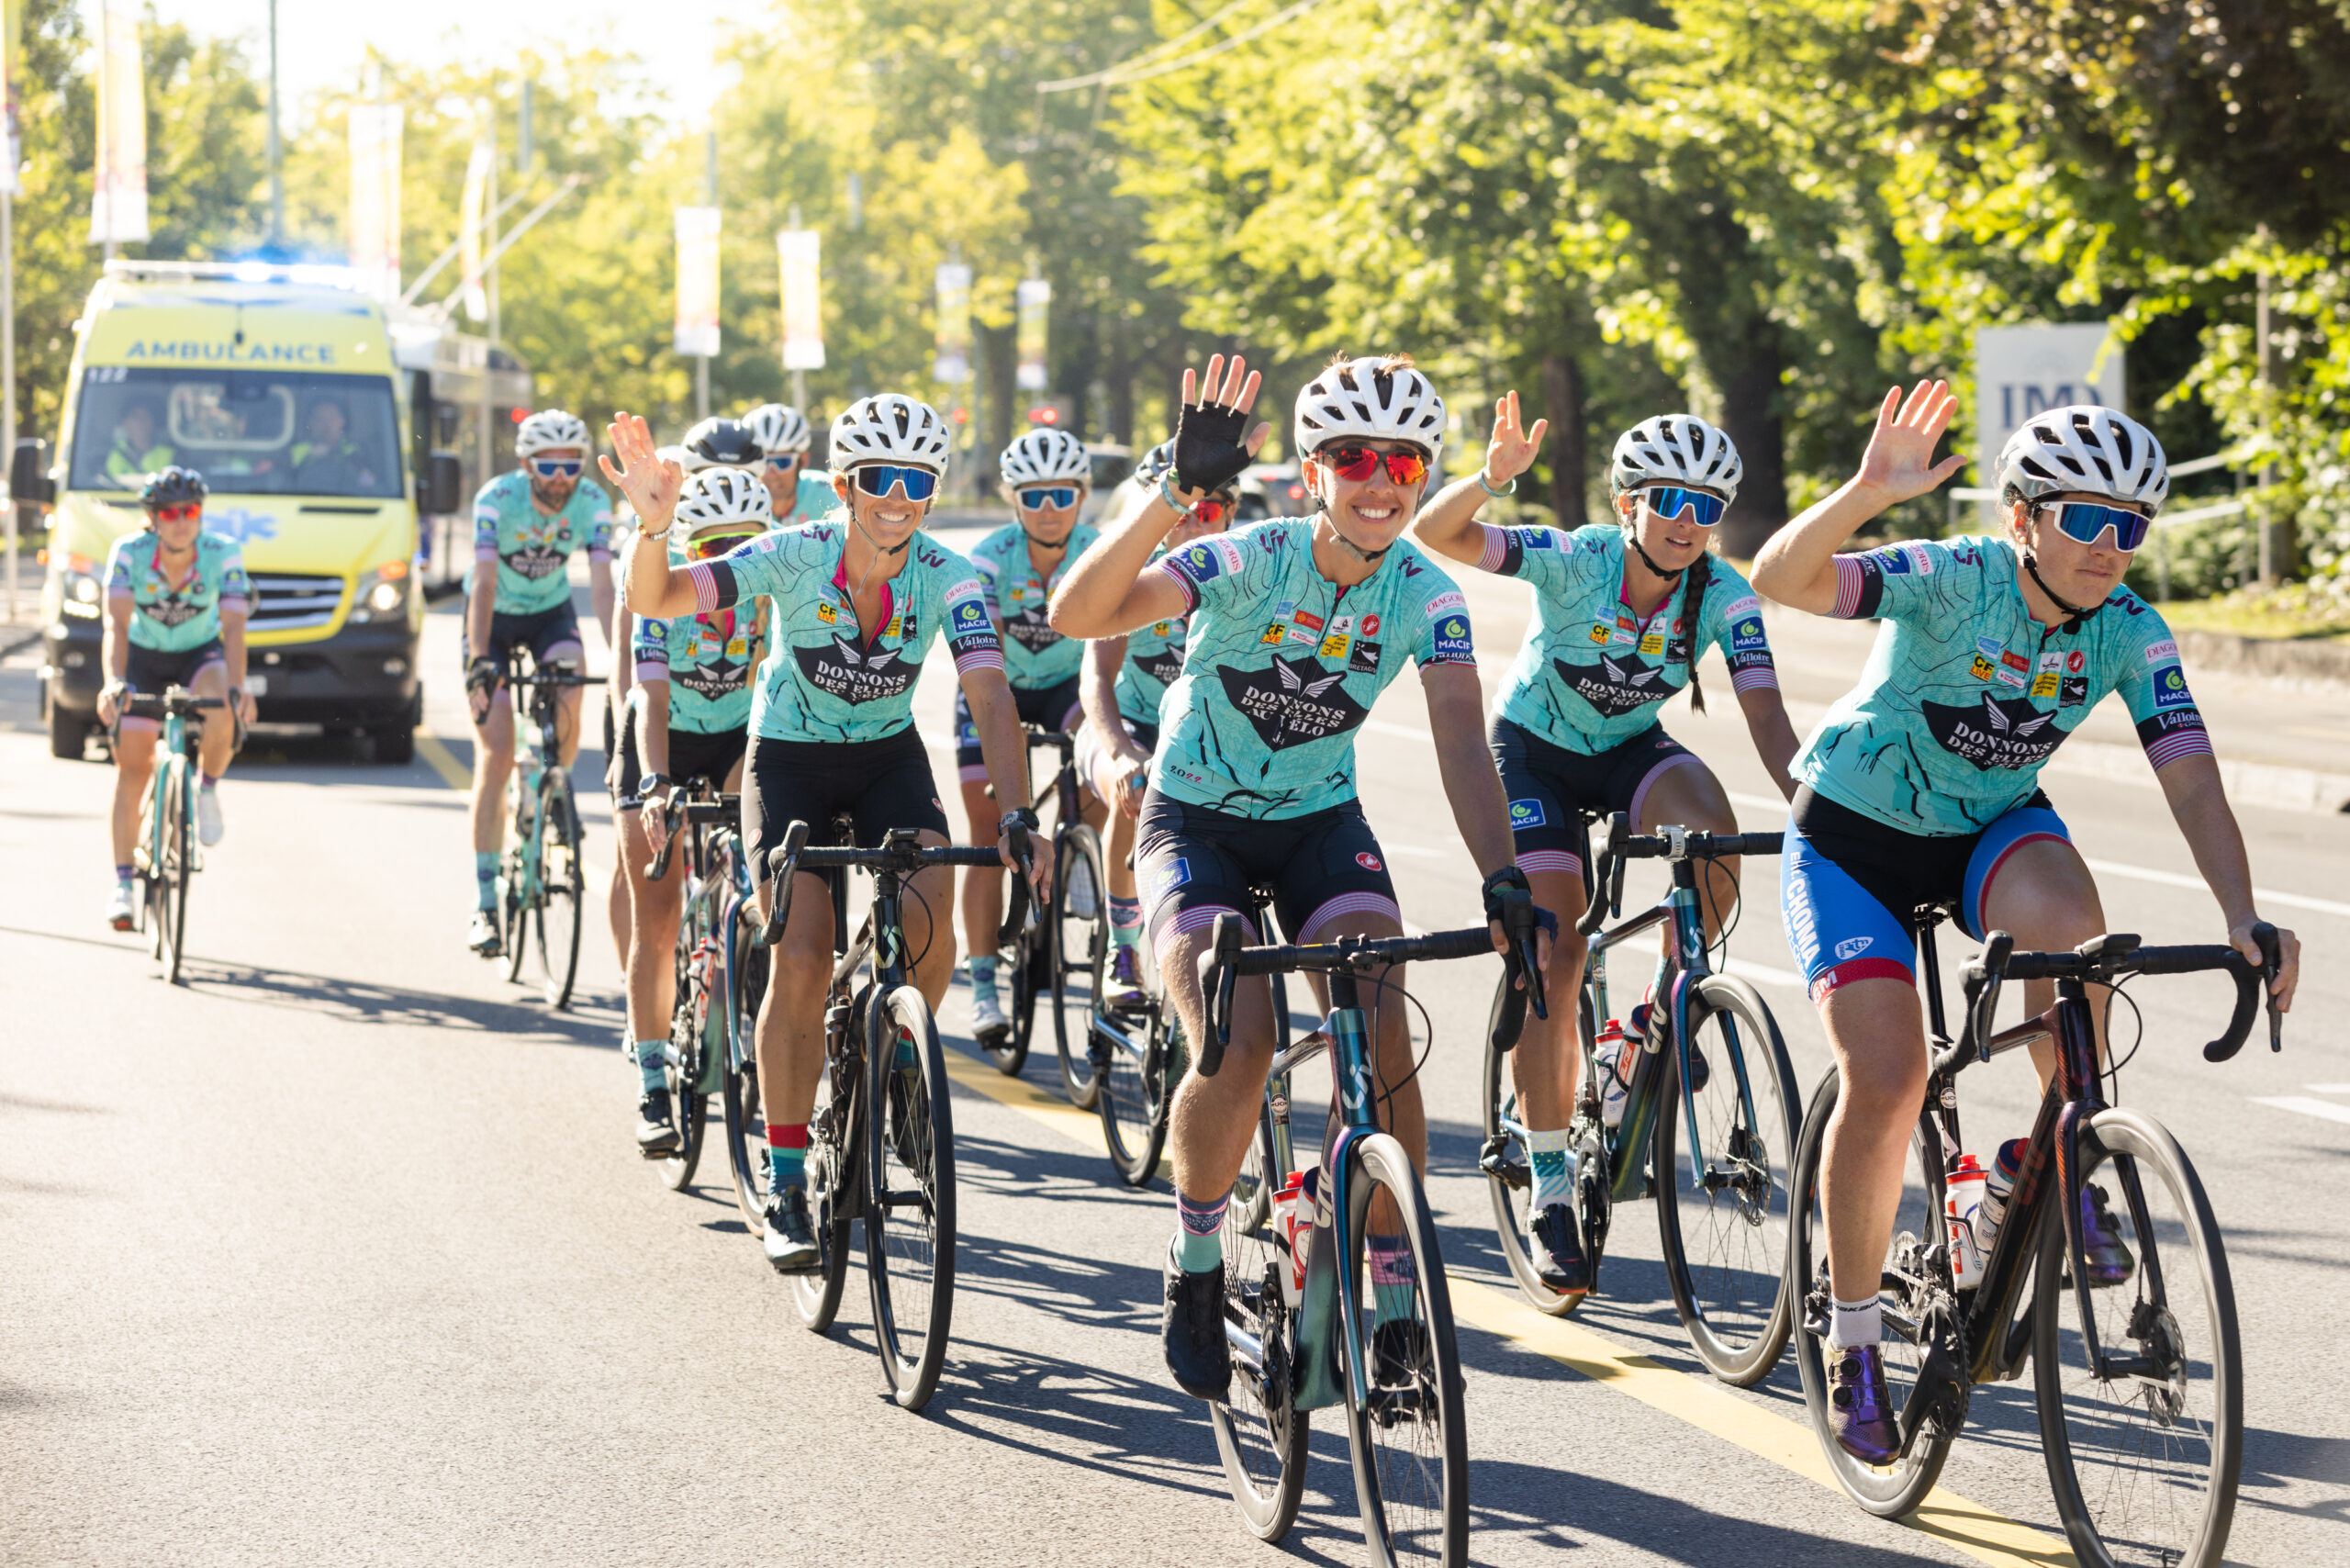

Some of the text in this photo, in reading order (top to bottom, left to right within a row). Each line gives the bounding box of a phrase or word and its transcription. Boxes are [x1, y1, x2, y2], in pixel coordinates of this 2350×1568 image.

[125, 341, 337, 364] AMBULANCE
[1523, 530, 1534, 545] CIF
[817, 610, 835, 624] LIVE
[819, 602, 837, 616] CF
[957, 619, 988, 632] MACIF
[1593, 624, 1611, 638] CF
[957, 635, 998, 651] Valloire
[1438, 639, 1471, 651] MACIF
[1736, 637, 1764, 647] MACIF
[1732, 652, 1770, 667] Valloire
[1974, 655, 1995, 672] CF
[814, 673, 847, 690] DES
[816, 660, 907, 688] DONNONS
[1970, 666, 1991, 681] LIVE
[1579, 677, 1665, 700] DONNONS
[1240, 695, 1279, 711] DES
[1245, 685, 1348, 722] DONNONS
[1947, 735, 1986, 756] DES
[1953, 722, 2054, 755] DONNONS
[1169, 765, 1203, 785] 2022
[1786, 878, 1821, 970] CHOMA
